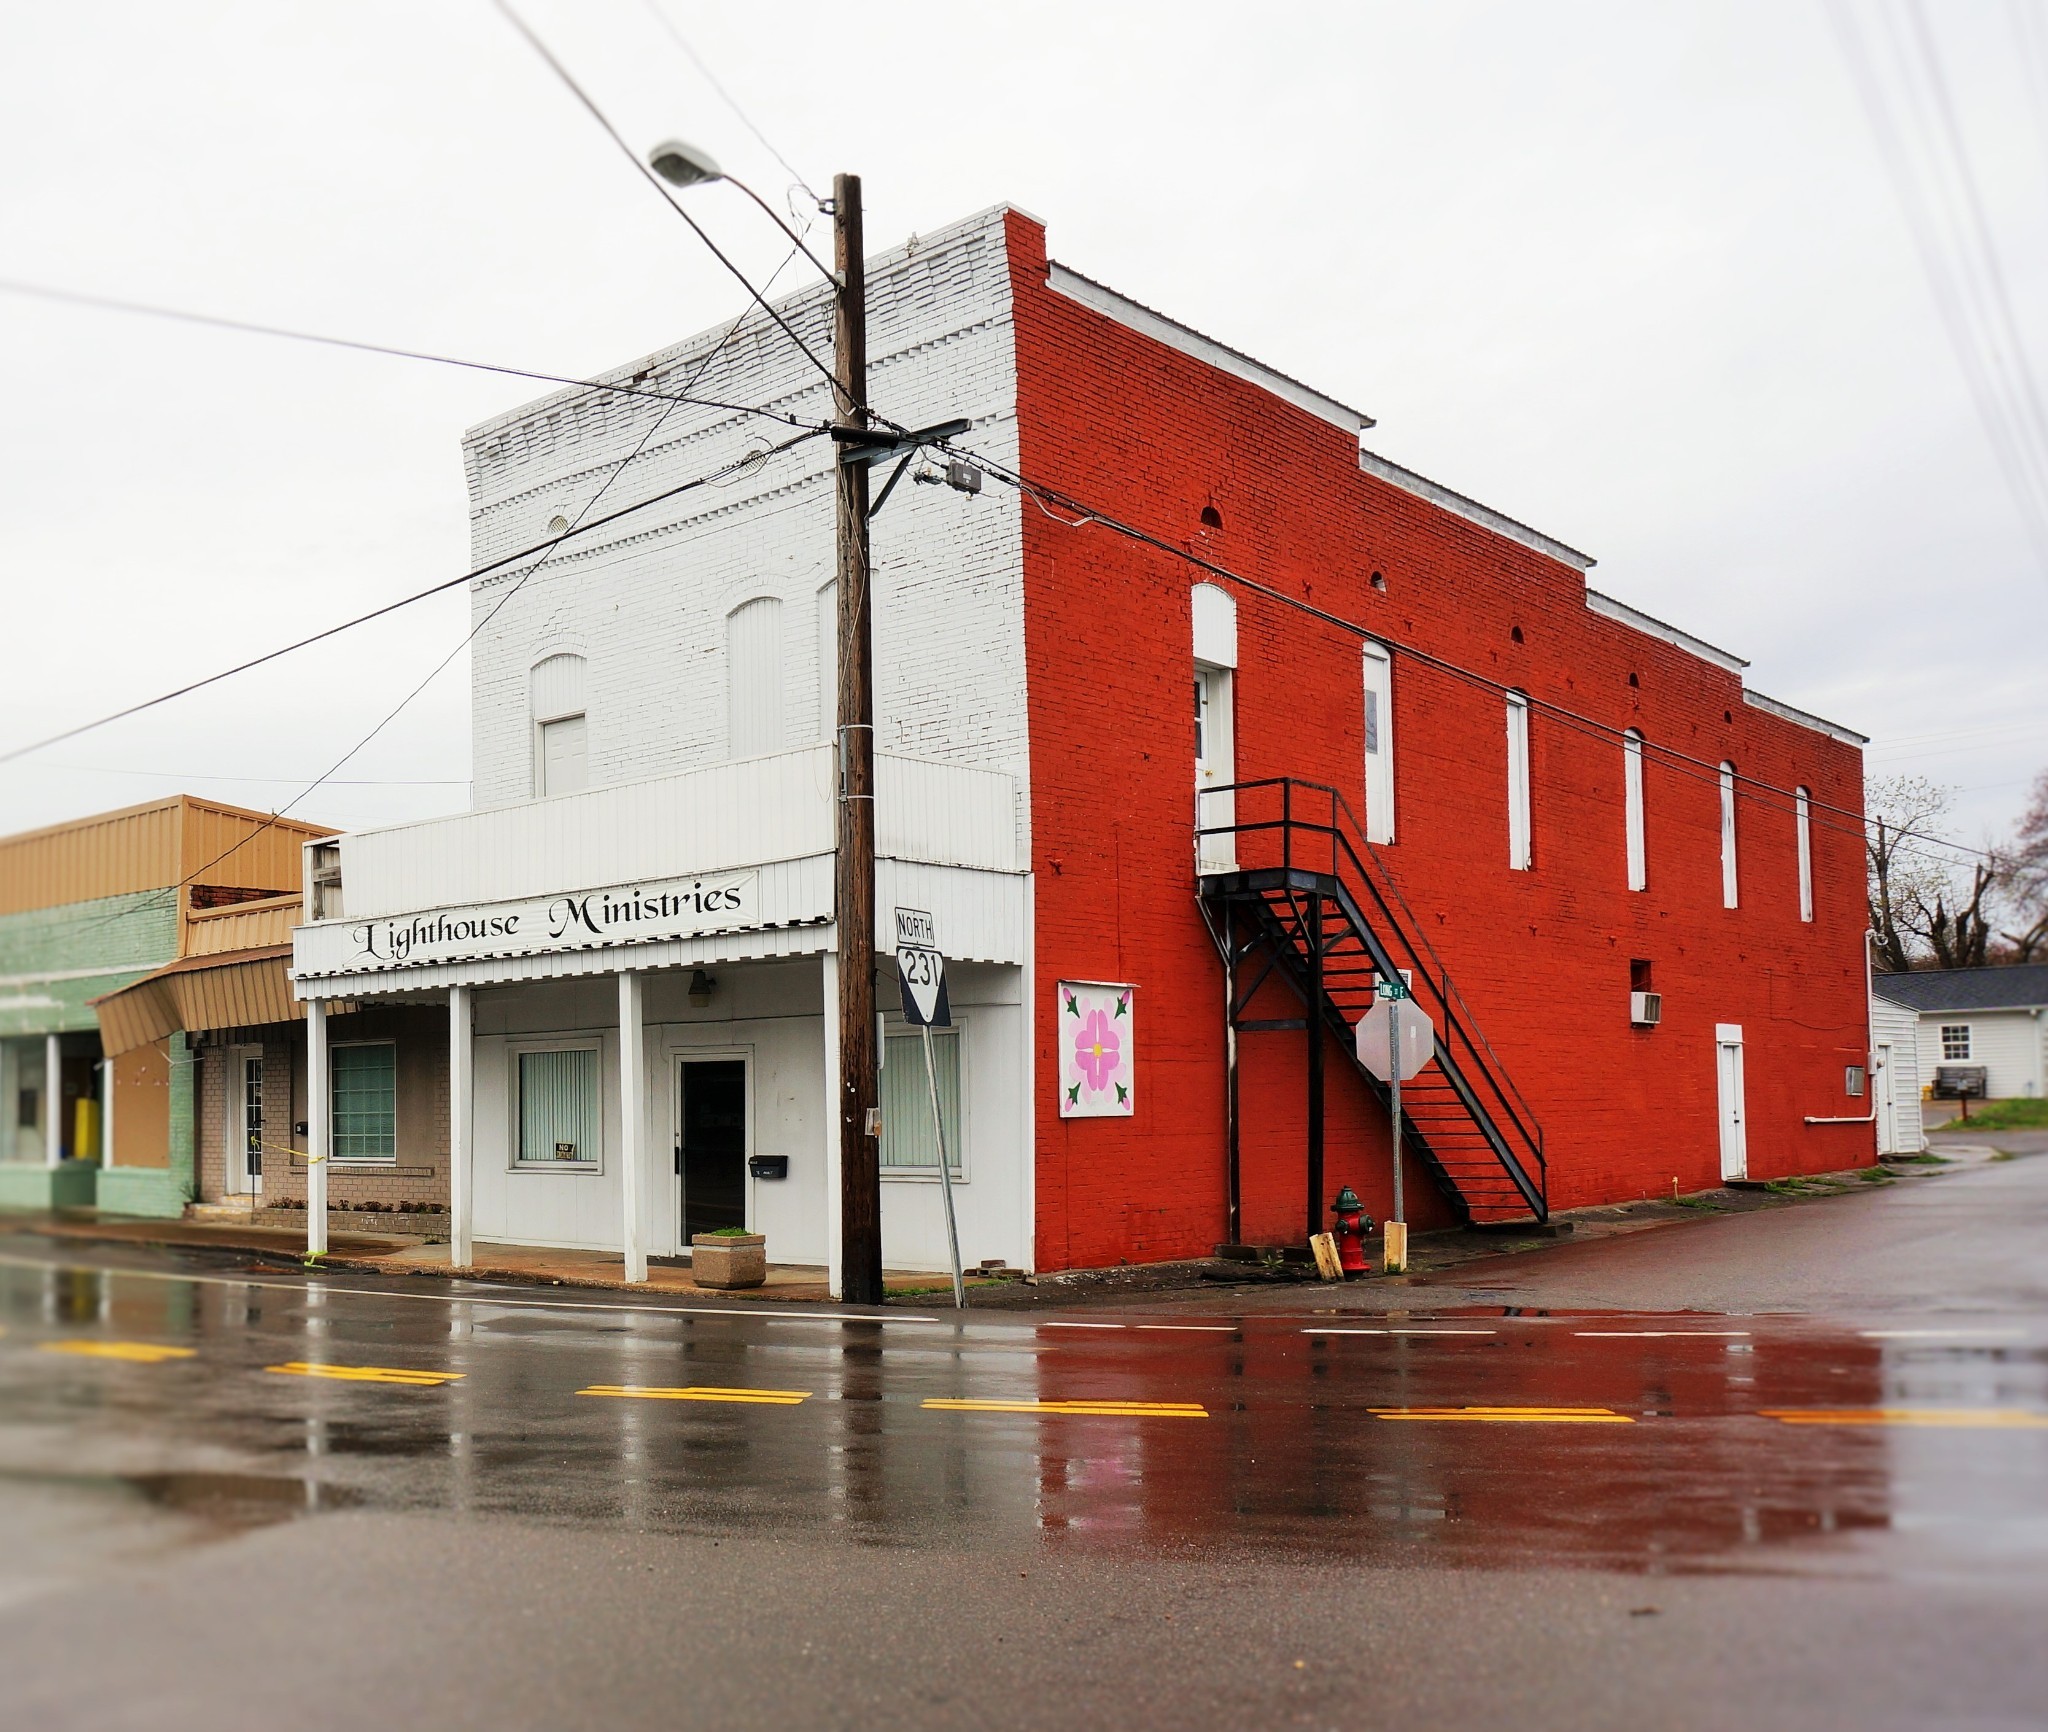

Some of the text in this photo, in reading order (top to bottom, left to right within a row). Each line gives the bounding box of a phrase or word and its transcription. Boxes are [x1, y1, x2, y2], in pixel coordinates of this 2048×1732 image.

[353, 882, 741, 960] Lighthouse Ministries
[897, 913, 933, 940] NORTH
[905, 951, 939, 986] 231
[558, 1144, 569, 1152] NO
